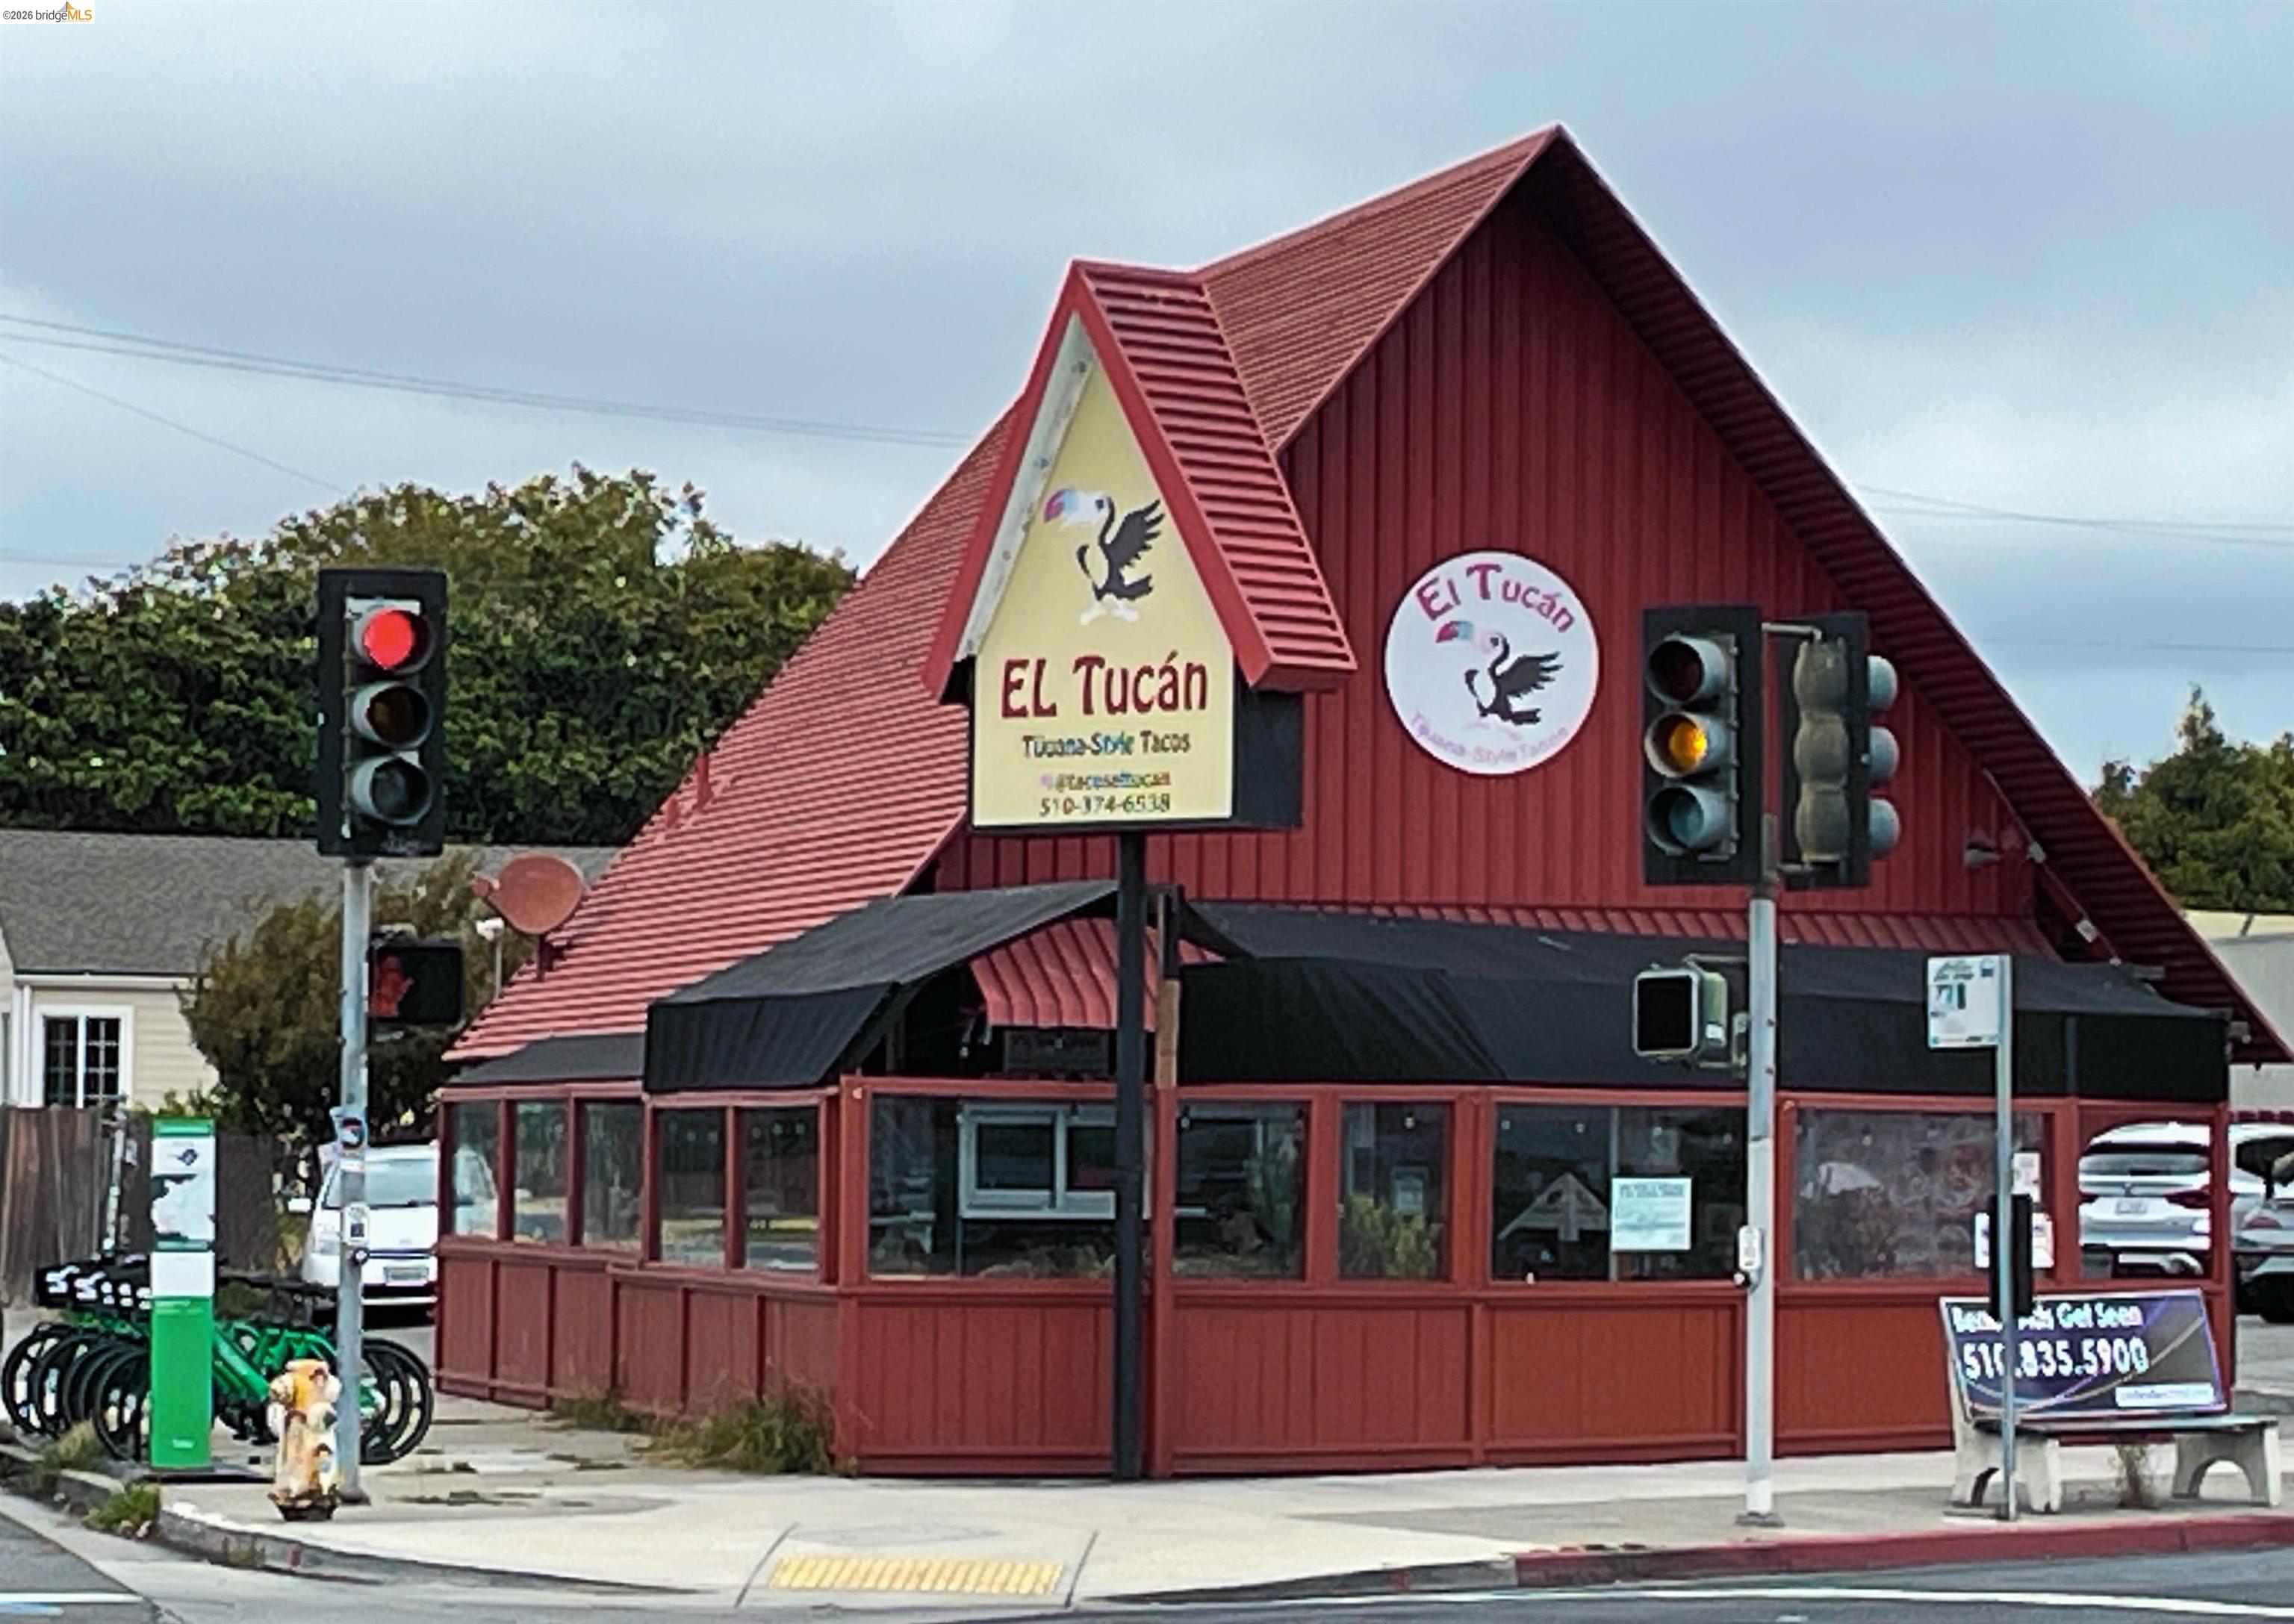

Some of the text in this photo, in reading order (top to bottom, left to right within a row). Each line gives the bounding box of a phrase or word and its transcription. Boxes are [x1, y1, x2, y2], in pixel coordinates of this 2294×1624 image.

[1416, 564, 1576, 633] El Tucán
[1072, 650, 1208, 715] Tucán
[1140, 729, 1191, 754] Tacos
[2056, 1302, 2093, 1329] Get
